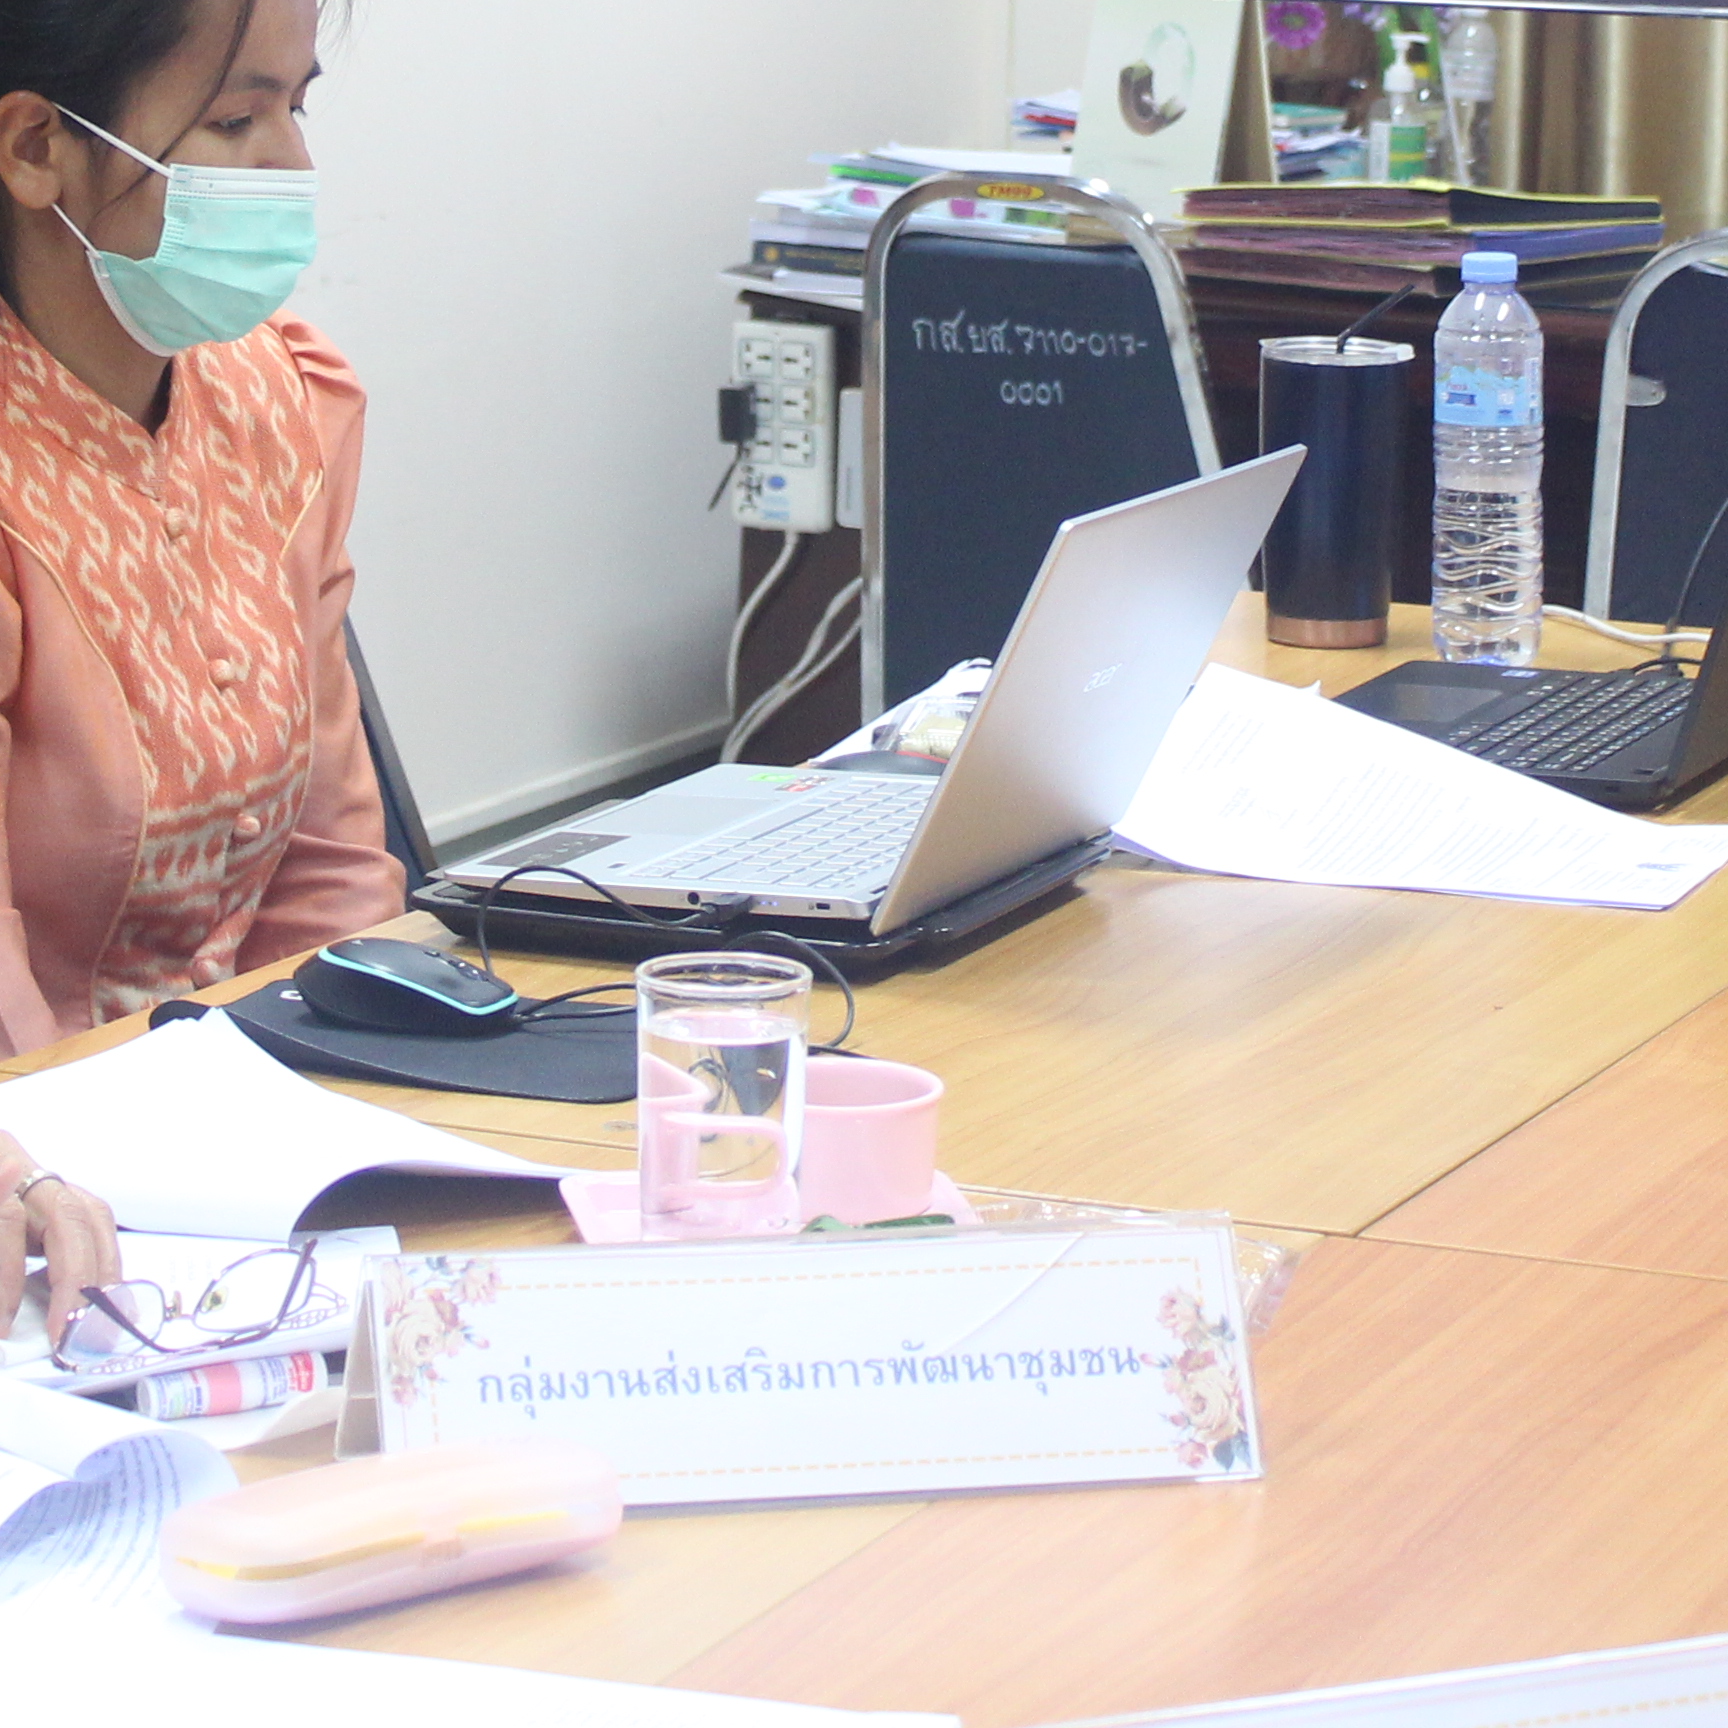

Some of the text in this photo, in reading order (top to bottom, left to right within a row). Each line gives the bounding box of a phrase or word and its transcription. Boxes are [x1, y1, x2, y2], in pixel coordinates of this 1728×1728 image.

[1000, 382, 1065, 406] 0001
[1082, 660, 1124, 692] acer
[477, 1338, 1144, 1419] กลุ่มงานส่งเสริมการพัฒนาชุมชน
